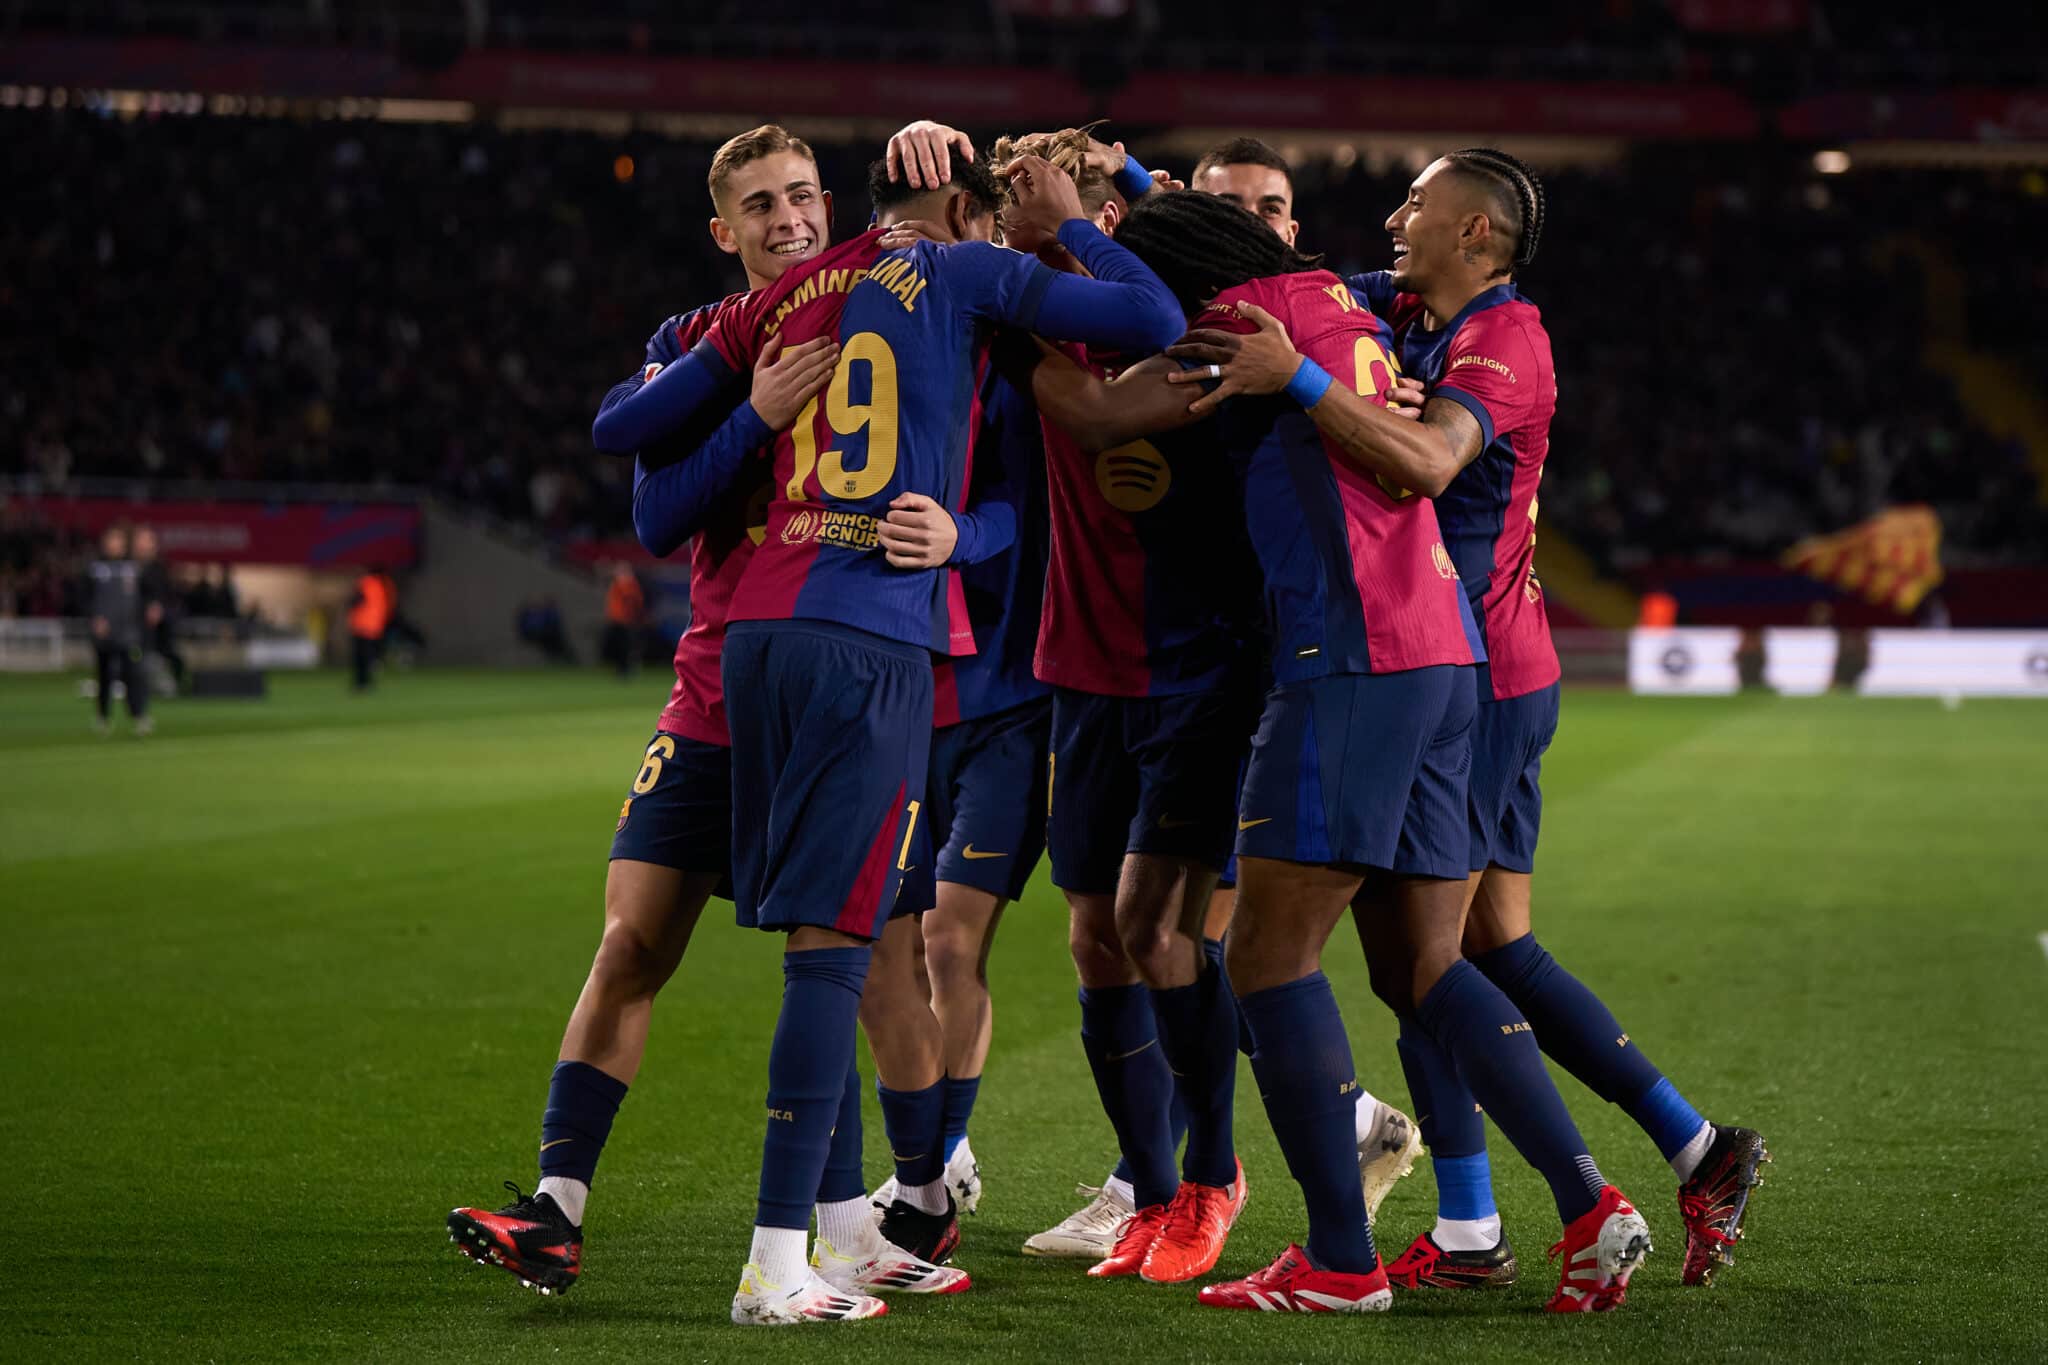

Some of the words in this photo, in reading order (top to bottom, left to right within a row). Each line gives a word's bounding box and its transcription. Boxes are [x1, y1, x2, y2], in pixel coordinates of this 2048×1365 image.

[781, 331, 899, 500] 19
[815, 525, 881, 548] ACNUR
[633, 735, 676, 794] 6
[897, 800, 920, 871] 1
